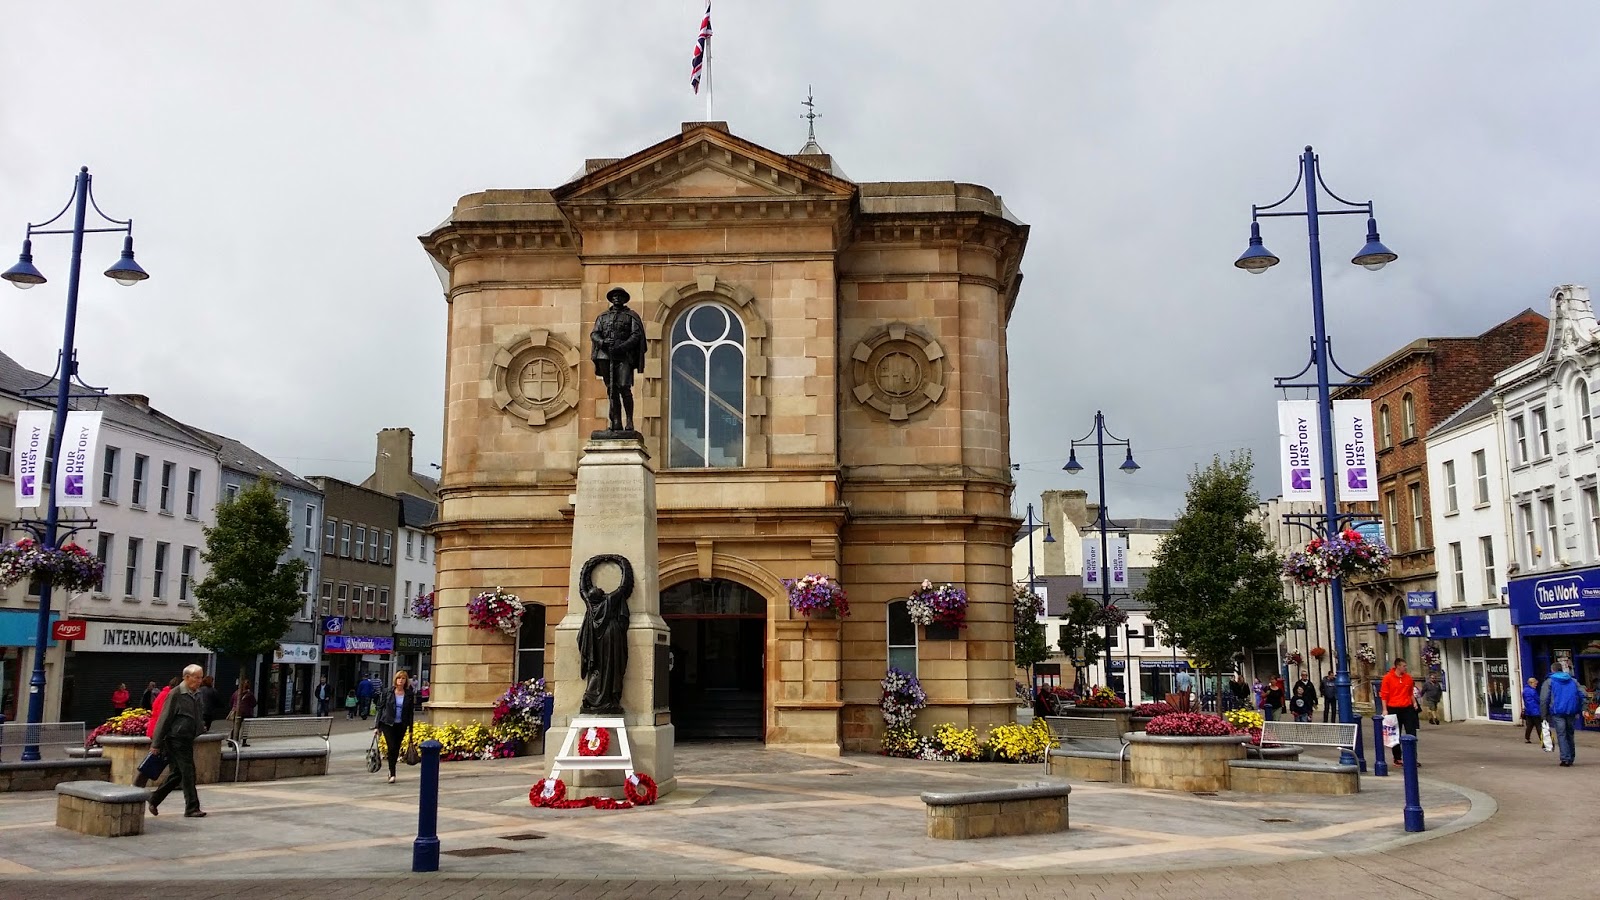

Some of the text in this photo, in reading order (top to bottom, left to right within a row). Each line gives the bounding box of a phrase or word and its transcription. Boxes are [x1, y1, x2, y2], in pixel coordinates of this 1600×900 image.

[28, 426, 41, 473] HISTORY
[75, 426, 90, 473] HISTORY
[1298, 417, 1310, 467] HISTORY
[1353, 416, 1366, 466] HISTORY
[20, 451, 28, 474] OUR
[65, 451, 76, 473] OUR
[1289, 444, 1299, 467] OUR
[1345, 443, 1355, 466] OUR
[1538, 582, 1579, 603] The Work
[1539, 608, 1585, 621] Discount Book Stores
[57, 623, 81, 634] Argos
[1403, 626, 1422, 635] AXA
[1487, 664, 1508, 673] 4 out of 5
